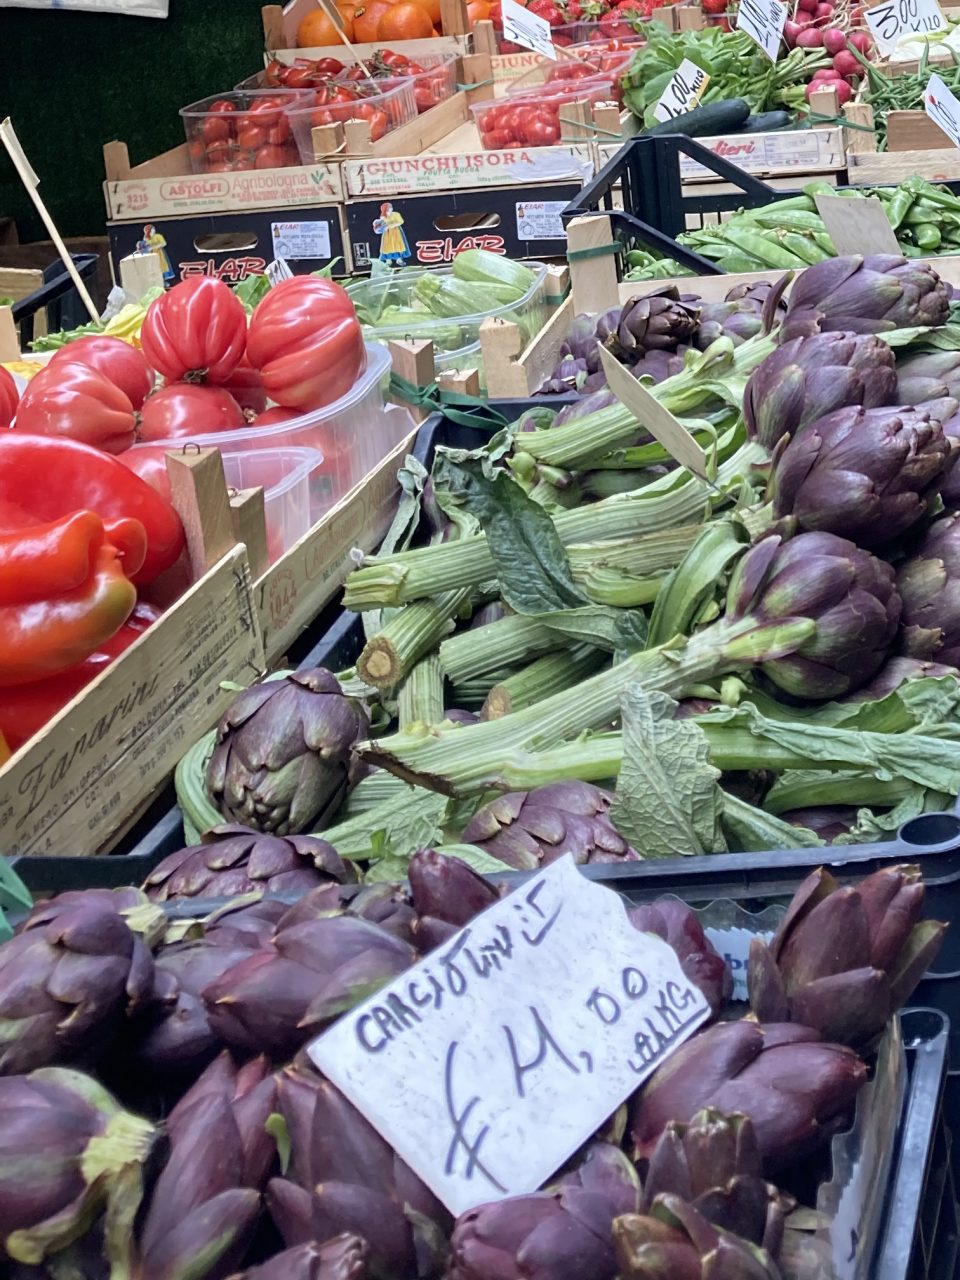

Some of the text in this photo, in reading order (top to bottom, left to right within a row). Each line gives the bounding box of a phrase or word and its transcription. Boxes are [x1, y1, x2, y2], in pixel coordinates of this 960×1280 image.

[910, 15, 940, 32] KILO
[491, 54, 541, 69] GIUNC
[710, 141, 756, 157] dieri
[366, 151, 535, 176] GIUNCHI ISORA
[169, 184, 222, 197] ASTOLFI
[232, 172, 308, 191] Agribologna
[416, 234, 506, 263] EIAR
[179, 256, 266, 282] EIAR
